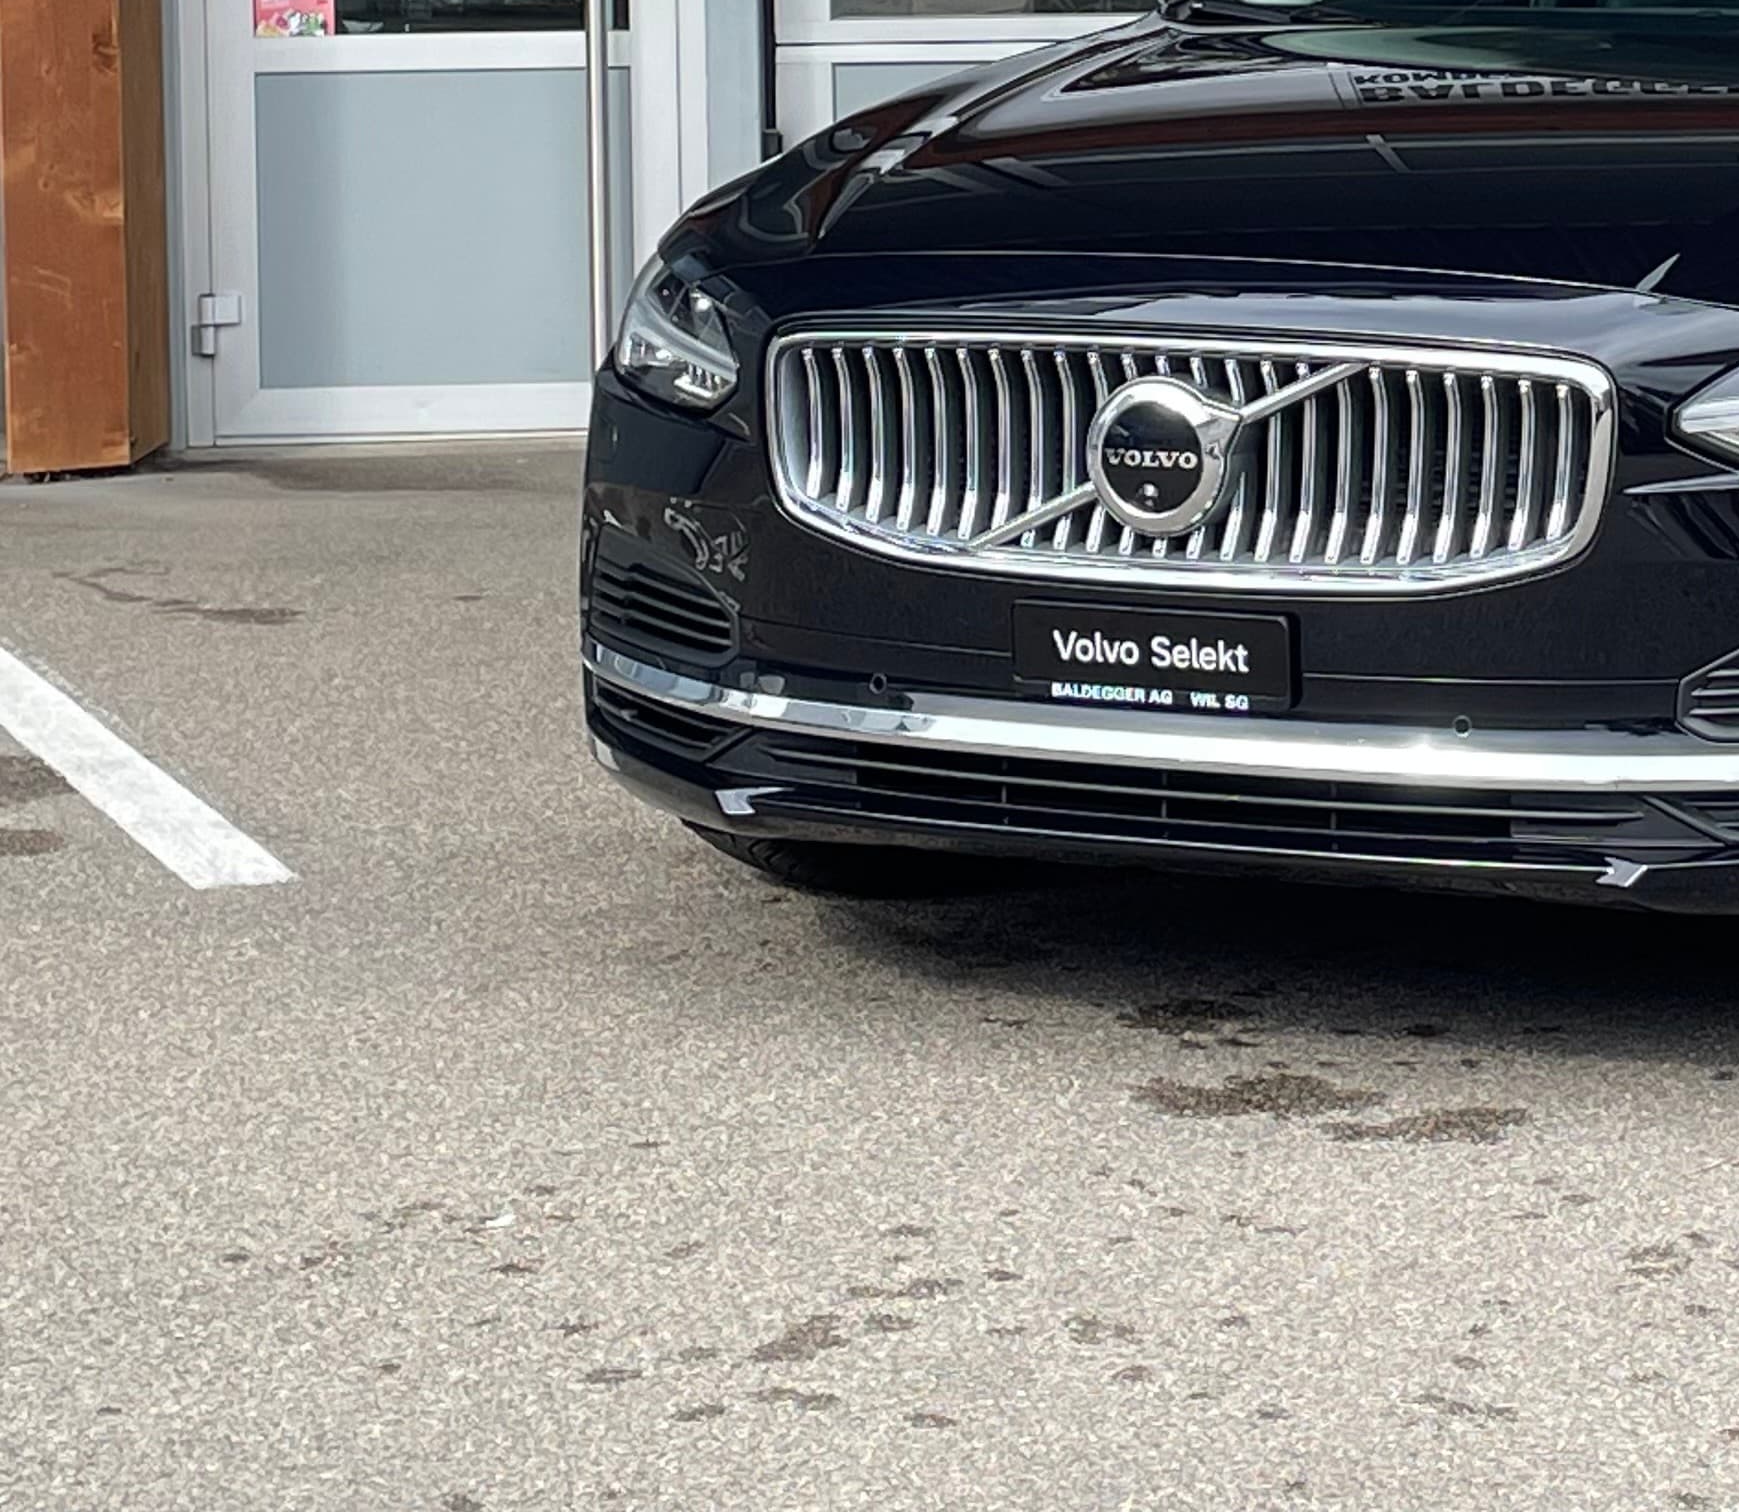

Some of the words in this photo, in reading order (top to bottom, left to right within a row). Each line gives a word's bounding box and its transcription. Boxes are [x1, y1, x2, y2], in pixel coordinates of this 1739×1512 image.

[1105, 448, 1199, 469] VOLVO
[1052, 629, 1140, 665] Volvo
[1150, 635, 1250, 673] Selekt
[1148, 689, 1173, 705] AG
